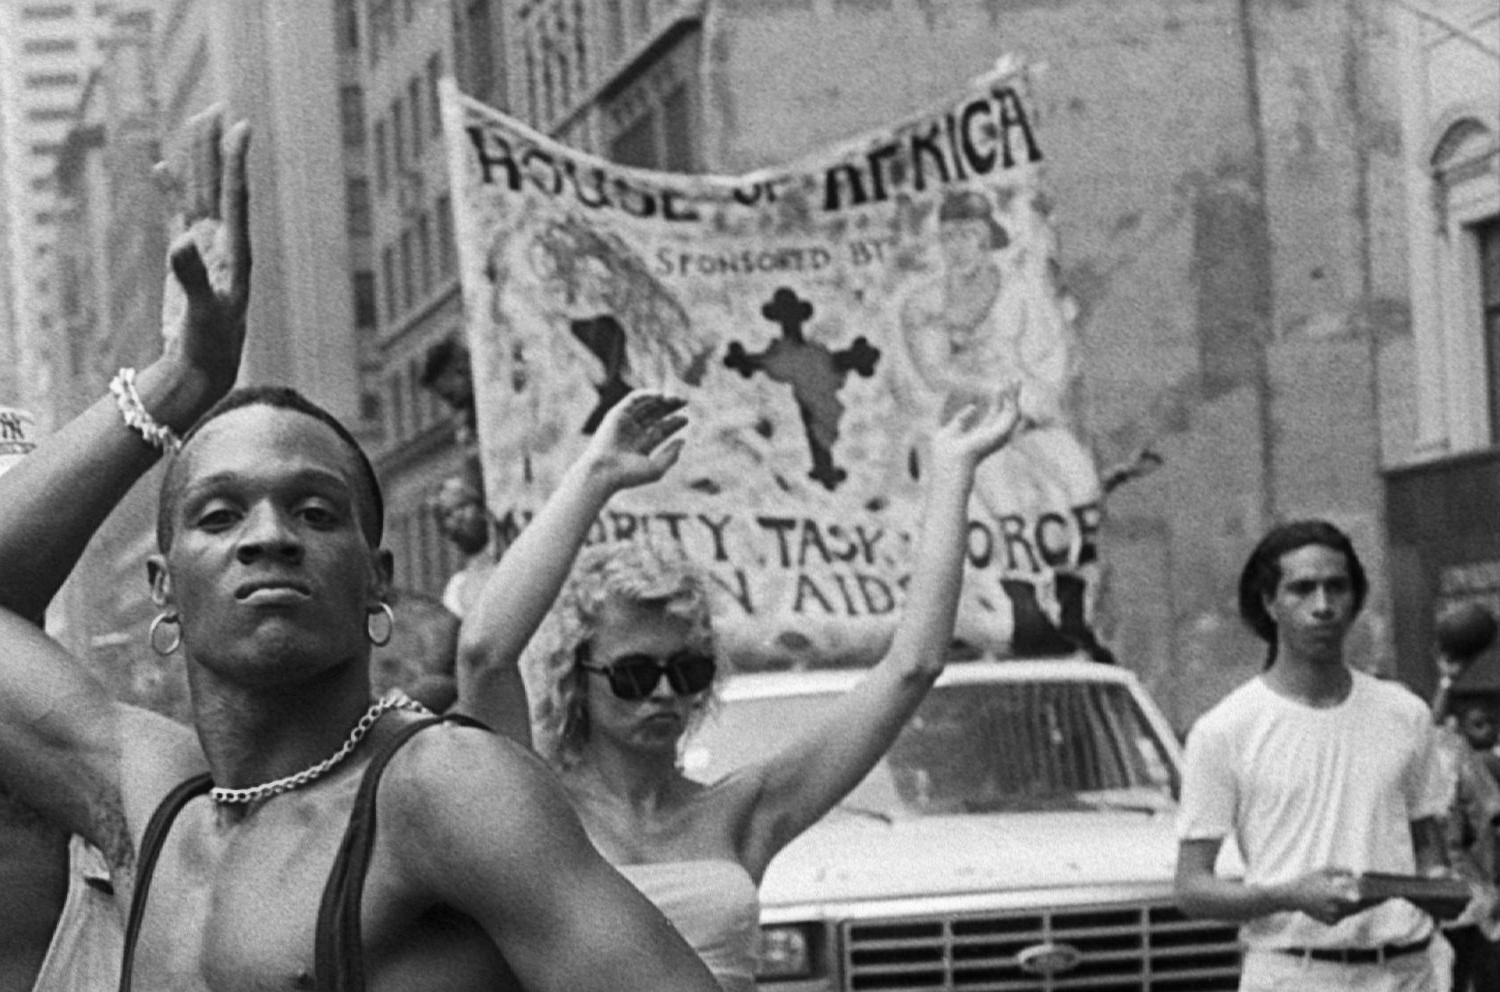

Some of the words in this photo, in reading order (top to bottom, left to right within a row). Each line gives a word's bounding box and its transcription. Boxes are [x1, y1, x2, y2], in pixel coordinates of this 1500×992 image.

[465, 126, 699, 222] HOUSE
[822, 86, 1044, 212] AFRICA
[966, 502, 1099, 573] ORCE
[794, 572, 912, 616] AID
